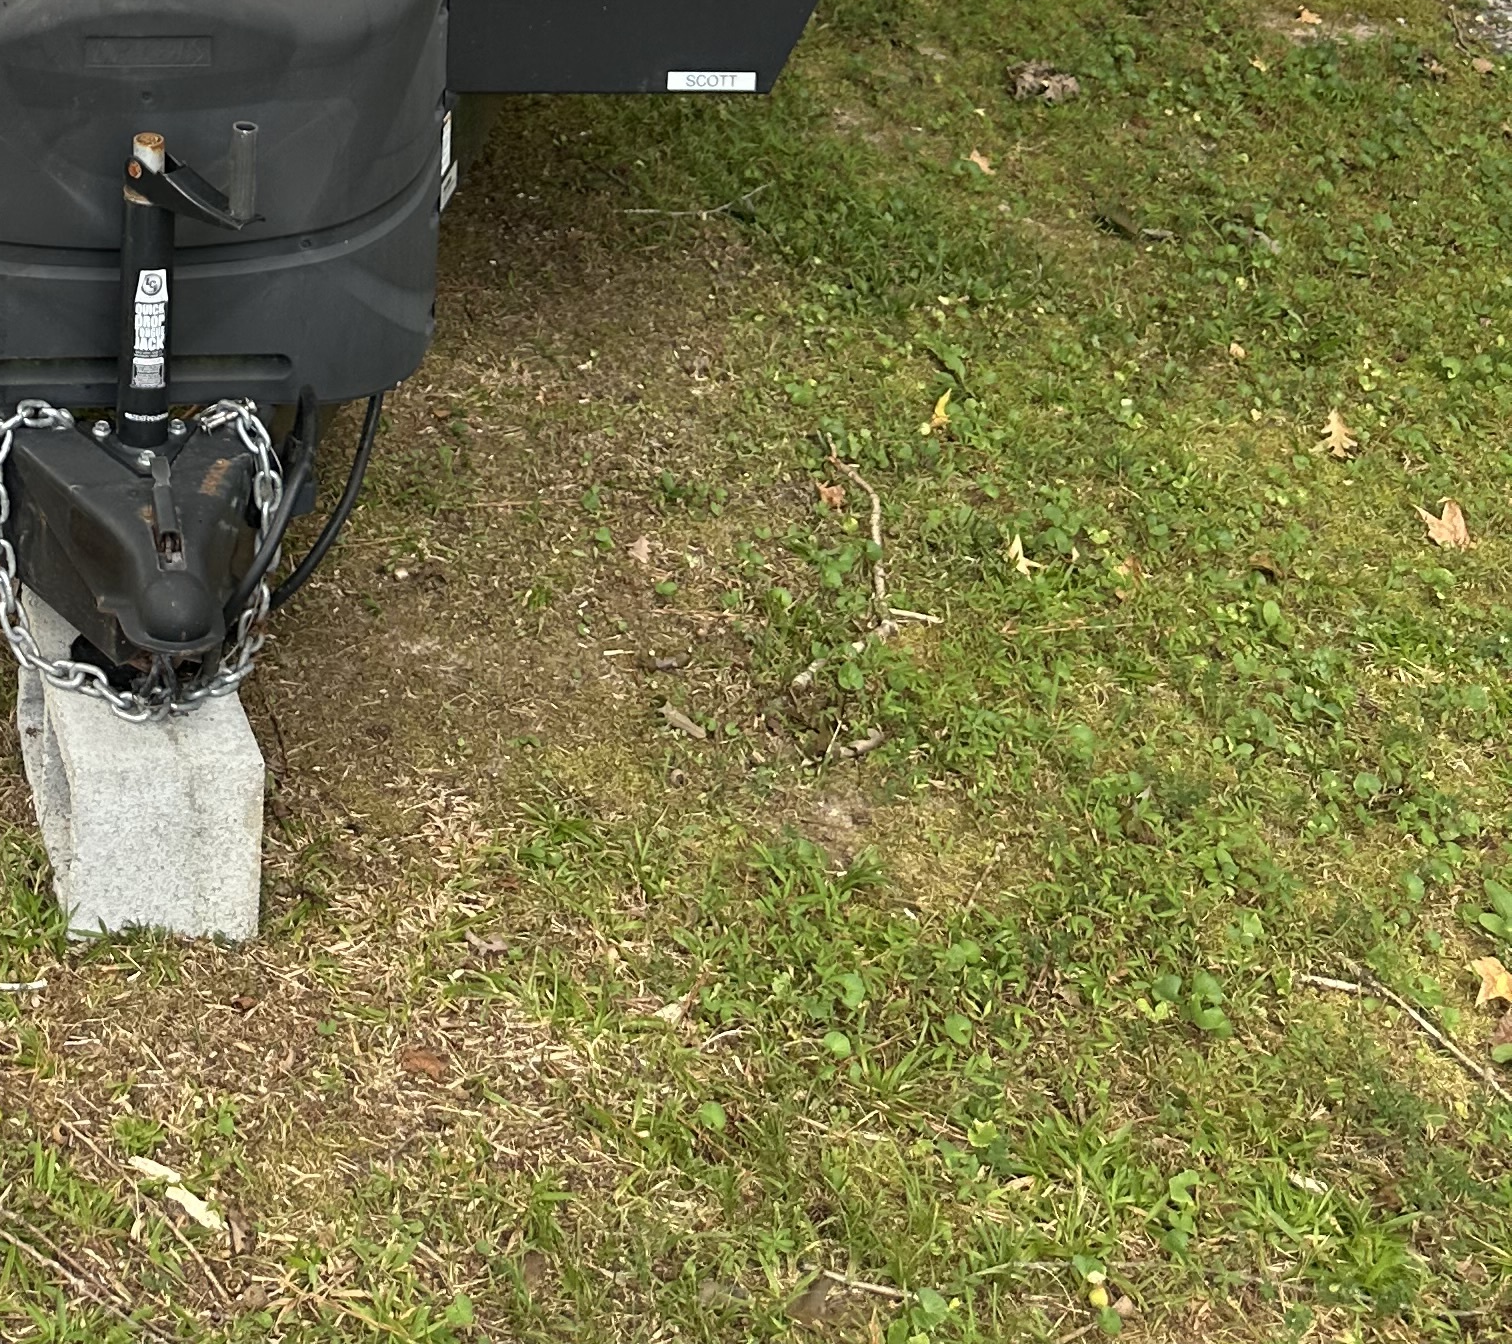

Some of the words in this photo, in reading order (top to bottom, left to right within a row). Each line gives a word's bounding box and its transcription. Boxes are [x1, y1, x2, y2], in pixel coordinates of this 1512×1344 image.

[686, 75, 737, 87] SCOTT
[135, 303, 165, 314] QUICK
[135, 314, 165, 327] DROP
[134, 337, 164, 350] JACK
